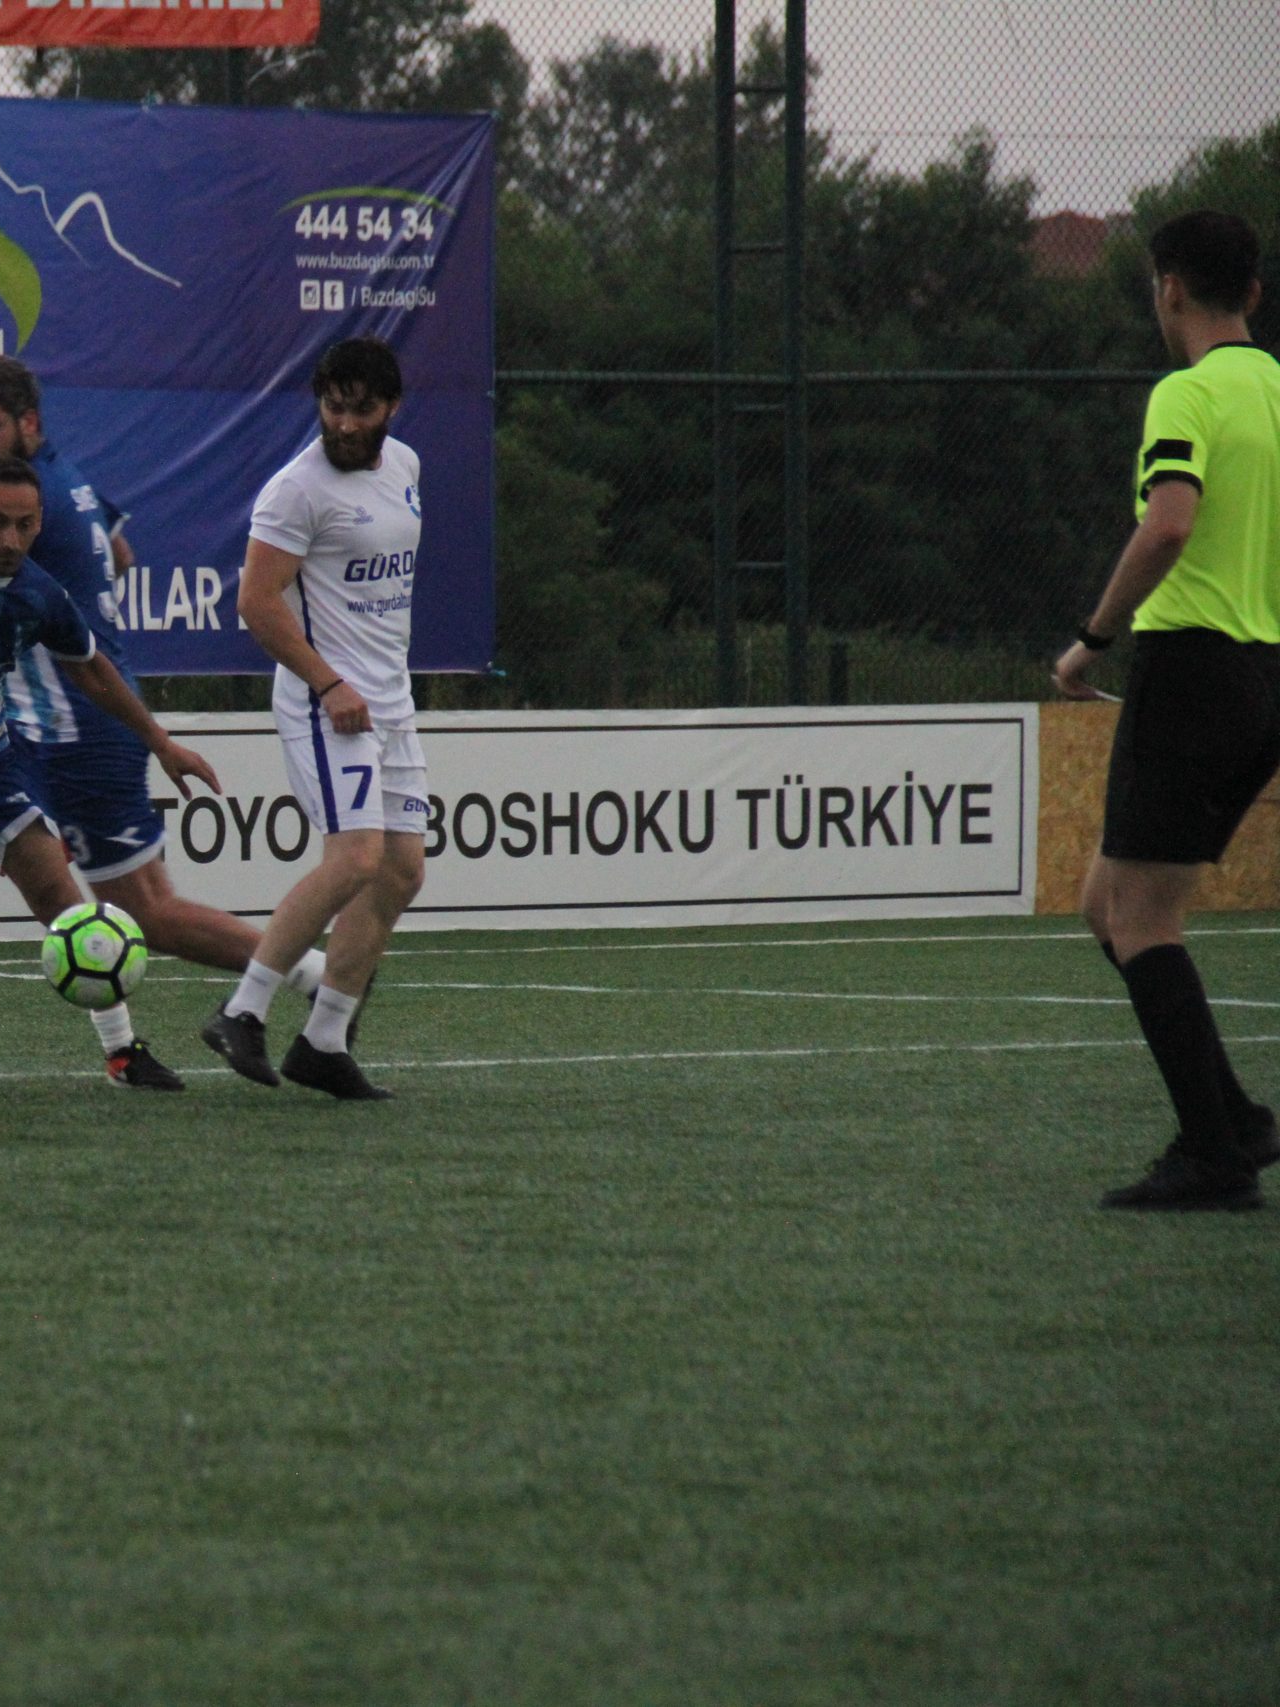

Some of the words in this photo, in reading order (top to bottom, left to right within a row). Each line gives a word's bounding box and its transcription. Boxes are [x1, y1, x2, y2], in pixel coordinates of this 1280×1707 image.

[295, 204, 349, 240] 444
[356, 206, 392, 241] 54
[401, 207, 434, 241] 34
[295, 251, 436, 274] www.buzdagisu.com.tr
[341, 764, 373, 811] 7
[424, 788, 715, 859] BOSHOKU
[735, 770, 993, 850] TÜRKİYE
